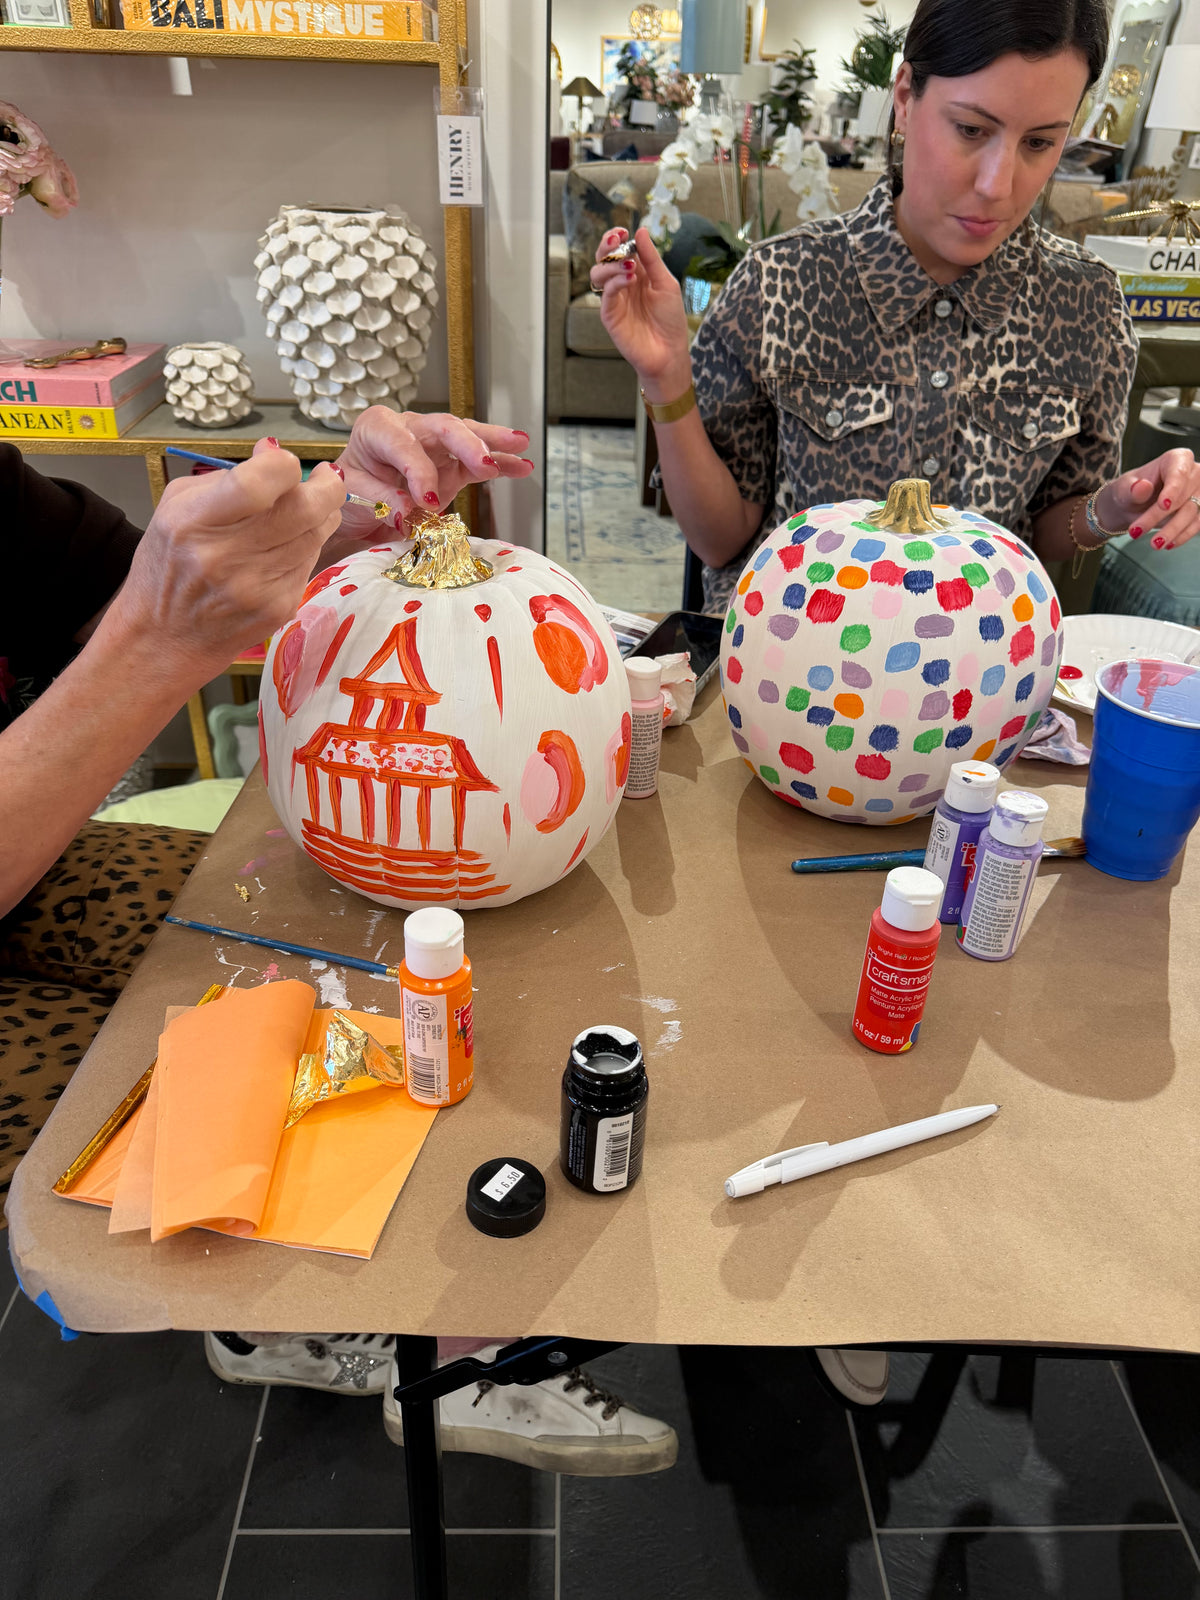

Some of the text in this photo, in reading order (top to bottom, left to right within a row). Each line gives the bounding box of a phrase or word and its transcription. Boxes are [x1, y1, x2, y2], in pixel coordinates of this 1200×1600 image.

[150, 0, 384, 36] BALI MYSTIQUE
[449, 124, 464, 197] HENRY
[1149, 250, 1200, 272] CHA
[1129, 299, 1163, 317] LAS
[0, 380, 38, 402] CH
[947, 907, 953, 915] 2
[870, 986, 889, 999] Matte
[890, 994, 912, 1003] Acrylic
[417, 1003, 431, 1019] AP
[870, 996, 896, 1011] Peinture
[888, 1011, 905, 1019] Mate
[880, 1035, 891, 1044] 59
[893, 1037, 904, 1045] ml
[500, 1171, 520, 1189] 6.50
